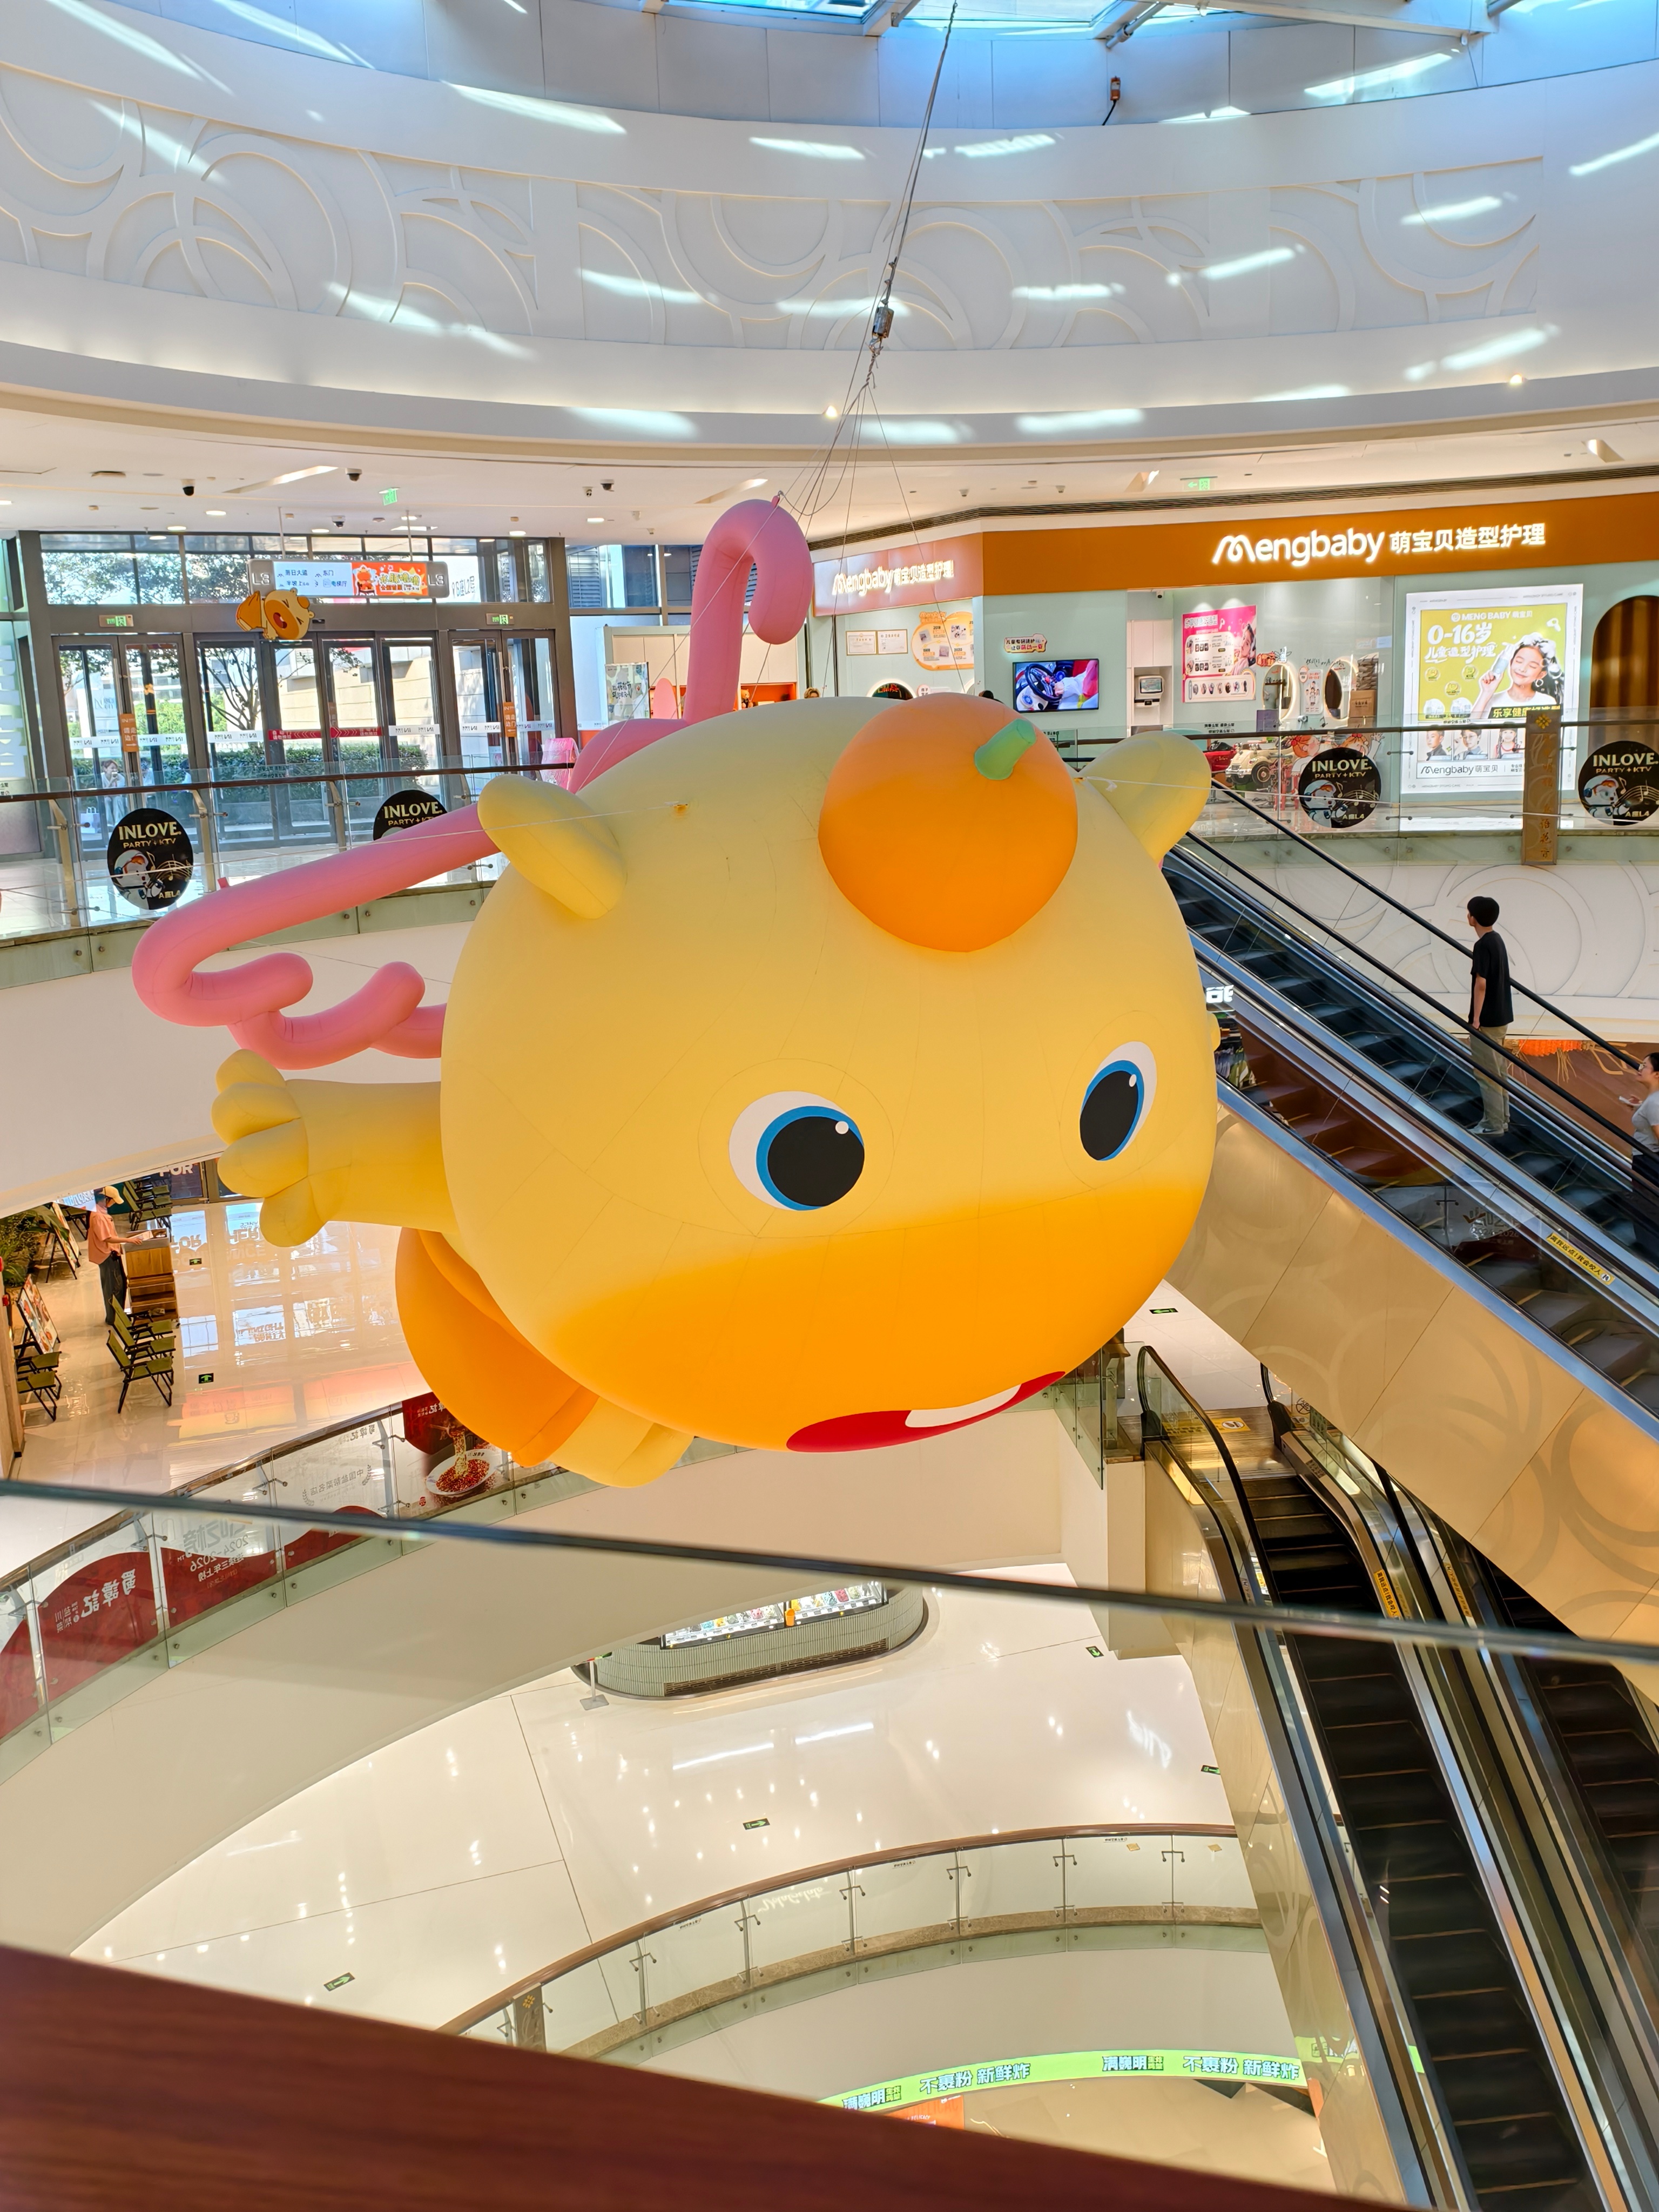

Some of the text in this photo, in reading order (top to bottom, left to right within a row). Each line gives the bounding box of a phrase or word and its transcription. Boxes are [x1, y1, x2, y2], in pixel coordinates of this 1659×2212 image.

[1212, 522, 1545, 567] Mengbaby 萌宝贝造型护理
[428, 574, 444, 586] L3
[832, 566, 894, 597] Mengbaby
[1461, 612, 1486, 621] MENG
[1487, 611, 1511, 619] BABY
[1427, 622, 1492, 645] 0-16岁
[1424, 642, 1498, 664] 儿童造型护理
[1421, 765, 1498, 775] Mengbaby 萌宝贝
[388, 818, 415, 826] PARTY
[123, 840, 152, 849] PARTY
[920, 2062, 1031, 2095] 不裹粉 新鲜炸
[1183, 2055, 1300, 2080] 不裹粉 新鲜炸
